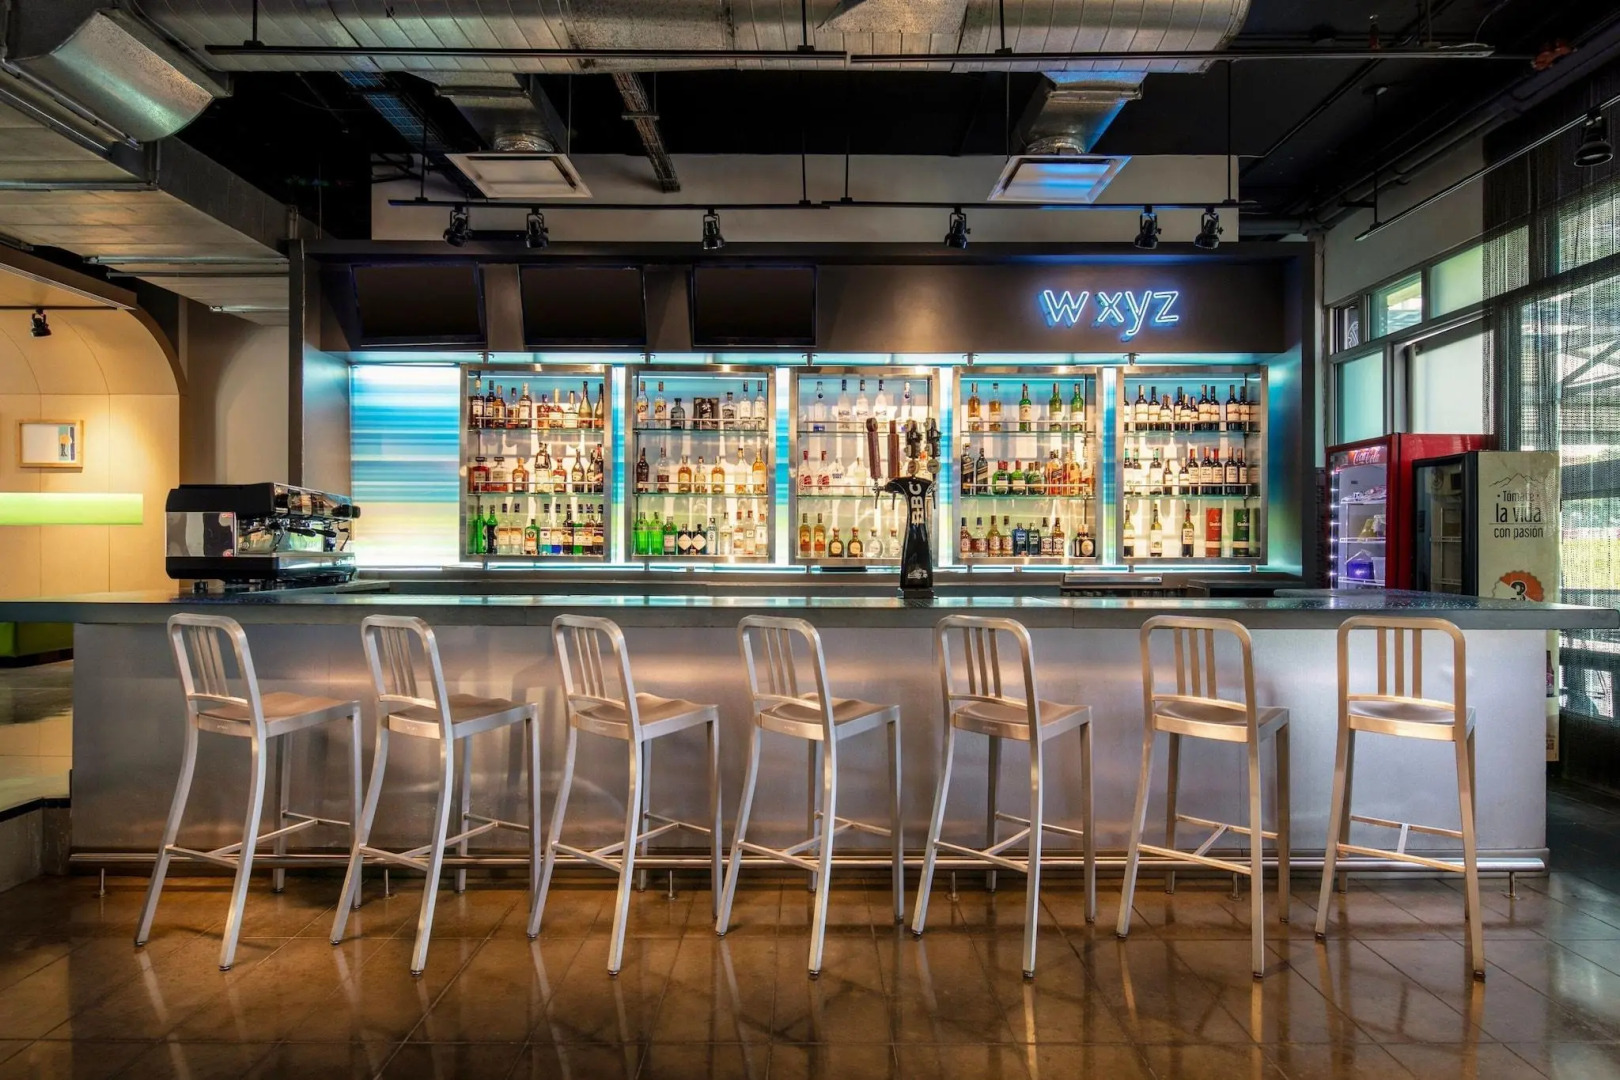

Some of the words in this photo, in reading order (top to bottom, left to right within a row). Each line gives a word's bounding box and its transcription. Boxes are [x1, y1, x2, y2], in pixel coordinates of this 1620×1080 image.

[1496, 503, 1508, 523] la
[1513, 502, 1541, 523] vida
[1494, 528, 1510, 539] con
[1514, 525, 1544, 541] pasión
